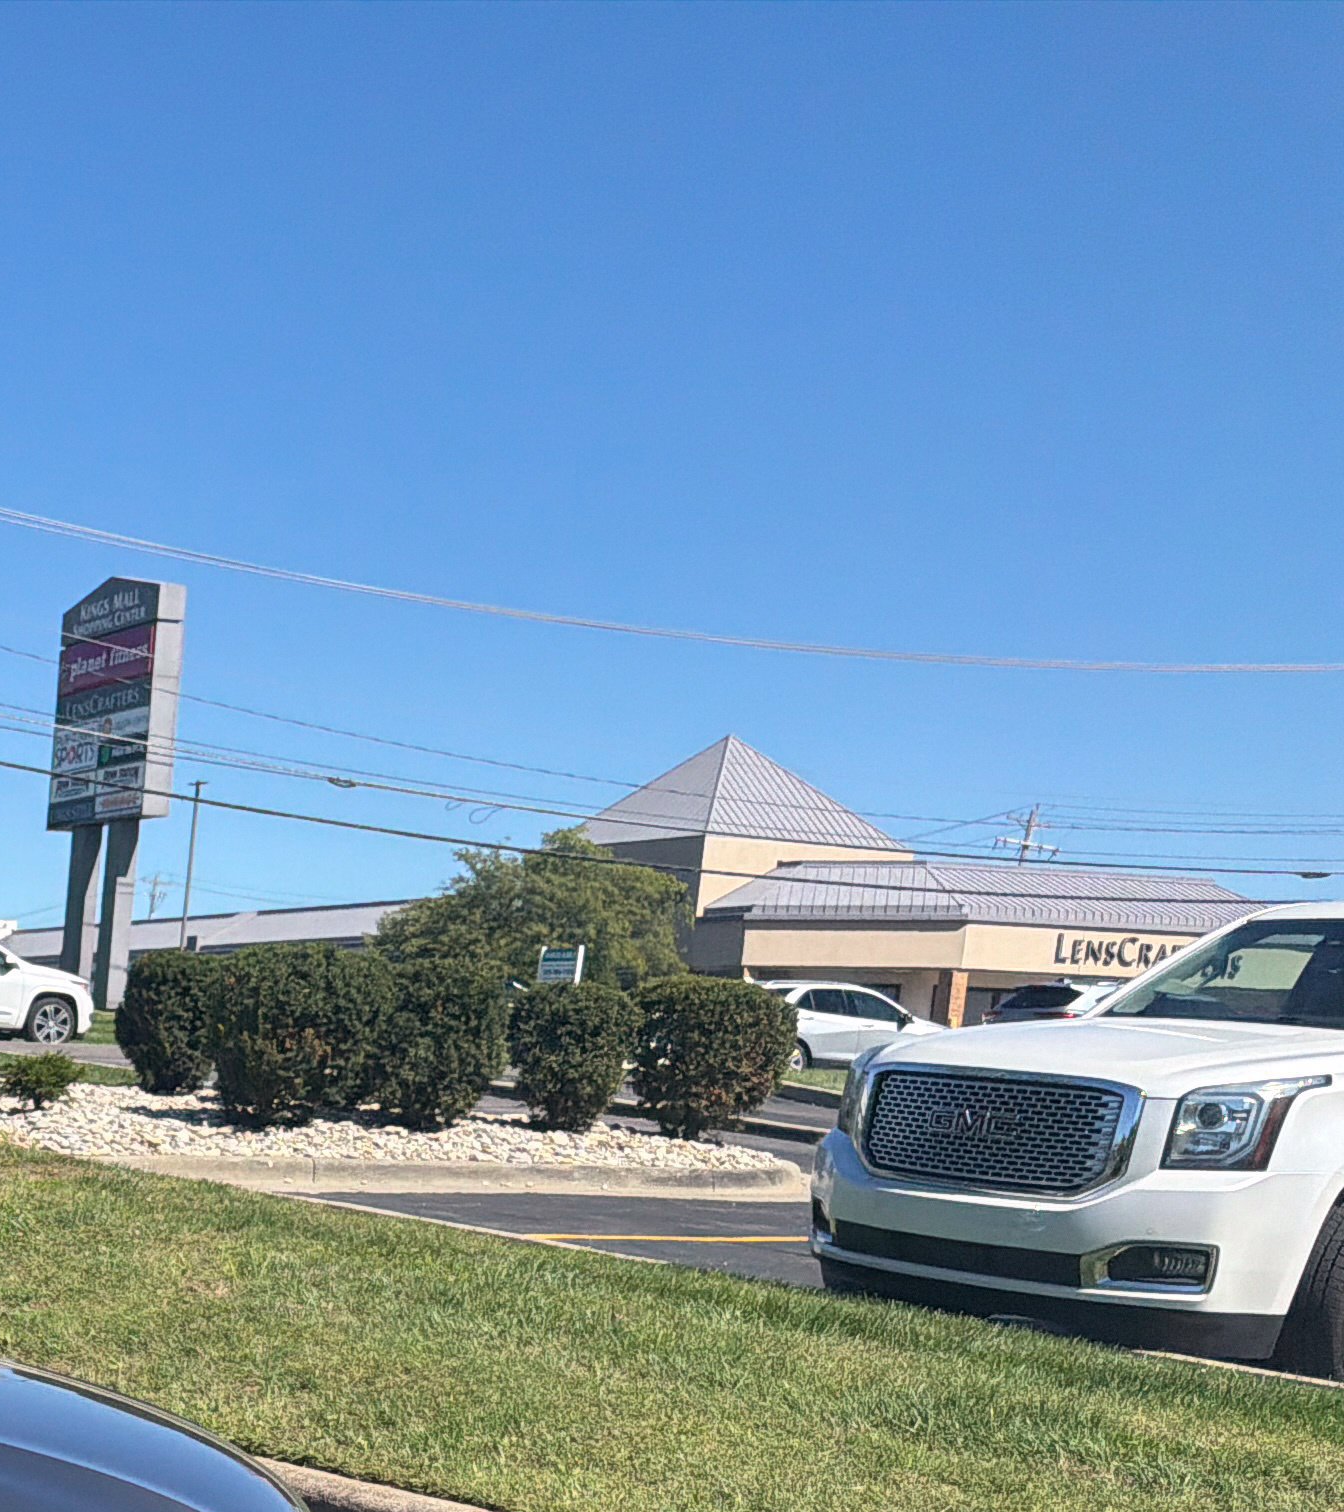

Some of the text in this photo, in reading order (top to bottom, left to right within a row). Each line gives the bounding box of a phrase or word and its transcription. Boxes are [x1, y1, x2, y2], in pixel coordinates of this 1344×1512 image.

[79, 588, 140, 621] KINGS MALL
[69, 649, 108, 682] planet
[929, 1107, 1019, 1138] GMC
